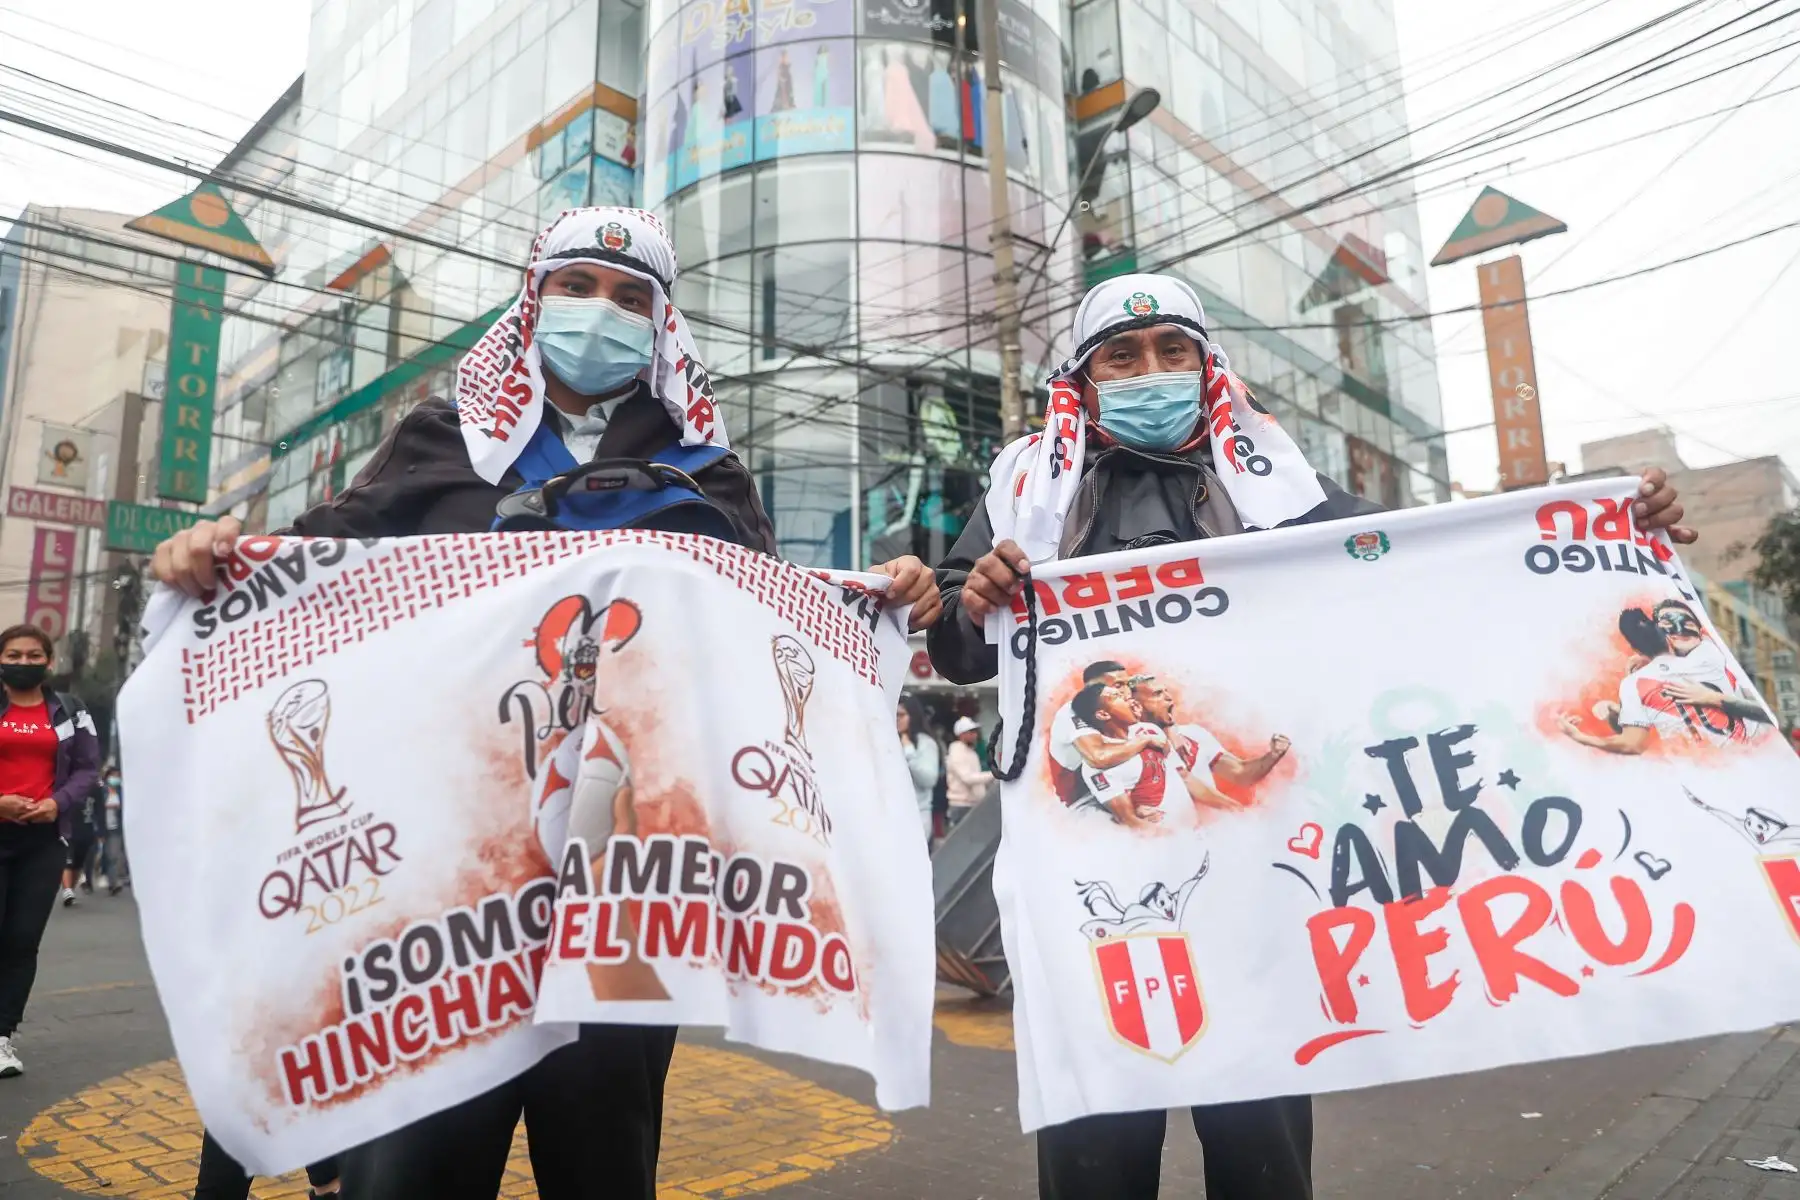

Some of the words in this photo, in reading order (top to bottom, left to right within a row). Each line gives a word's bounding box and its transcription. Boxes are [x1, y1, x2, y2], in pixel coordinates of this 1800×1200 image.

[174, 342, 211, 494] TORRE
[11, 491, 105, 523] GALERIA
[30, 532, 68, 642] LEO
[1525, 543, 1668, 577] NTIGO
[1011, 586, 1229, 660] CONTIGO
[1363, 723, 1484, 820] TE
[258, 821, 403, 919] QATAR
[276, 846, 302, 864] FIFA
[304, 824, 348, 851] WORLD
[350, 811, 374, 830] CUP
[1328, 796, 1583, 909] AMO
[300, 876, 387, 936] 2022
[343, 877, 557, 1015] ¡SOMO
[607, 838, 809, 919] MEOR
[1305, 848, 1653, 1026] PERÚ
[280, 944, 548, 1106] HINCHA
[552, 901, 624, 961] EL
[645, 900, 856, 993] MNDO
